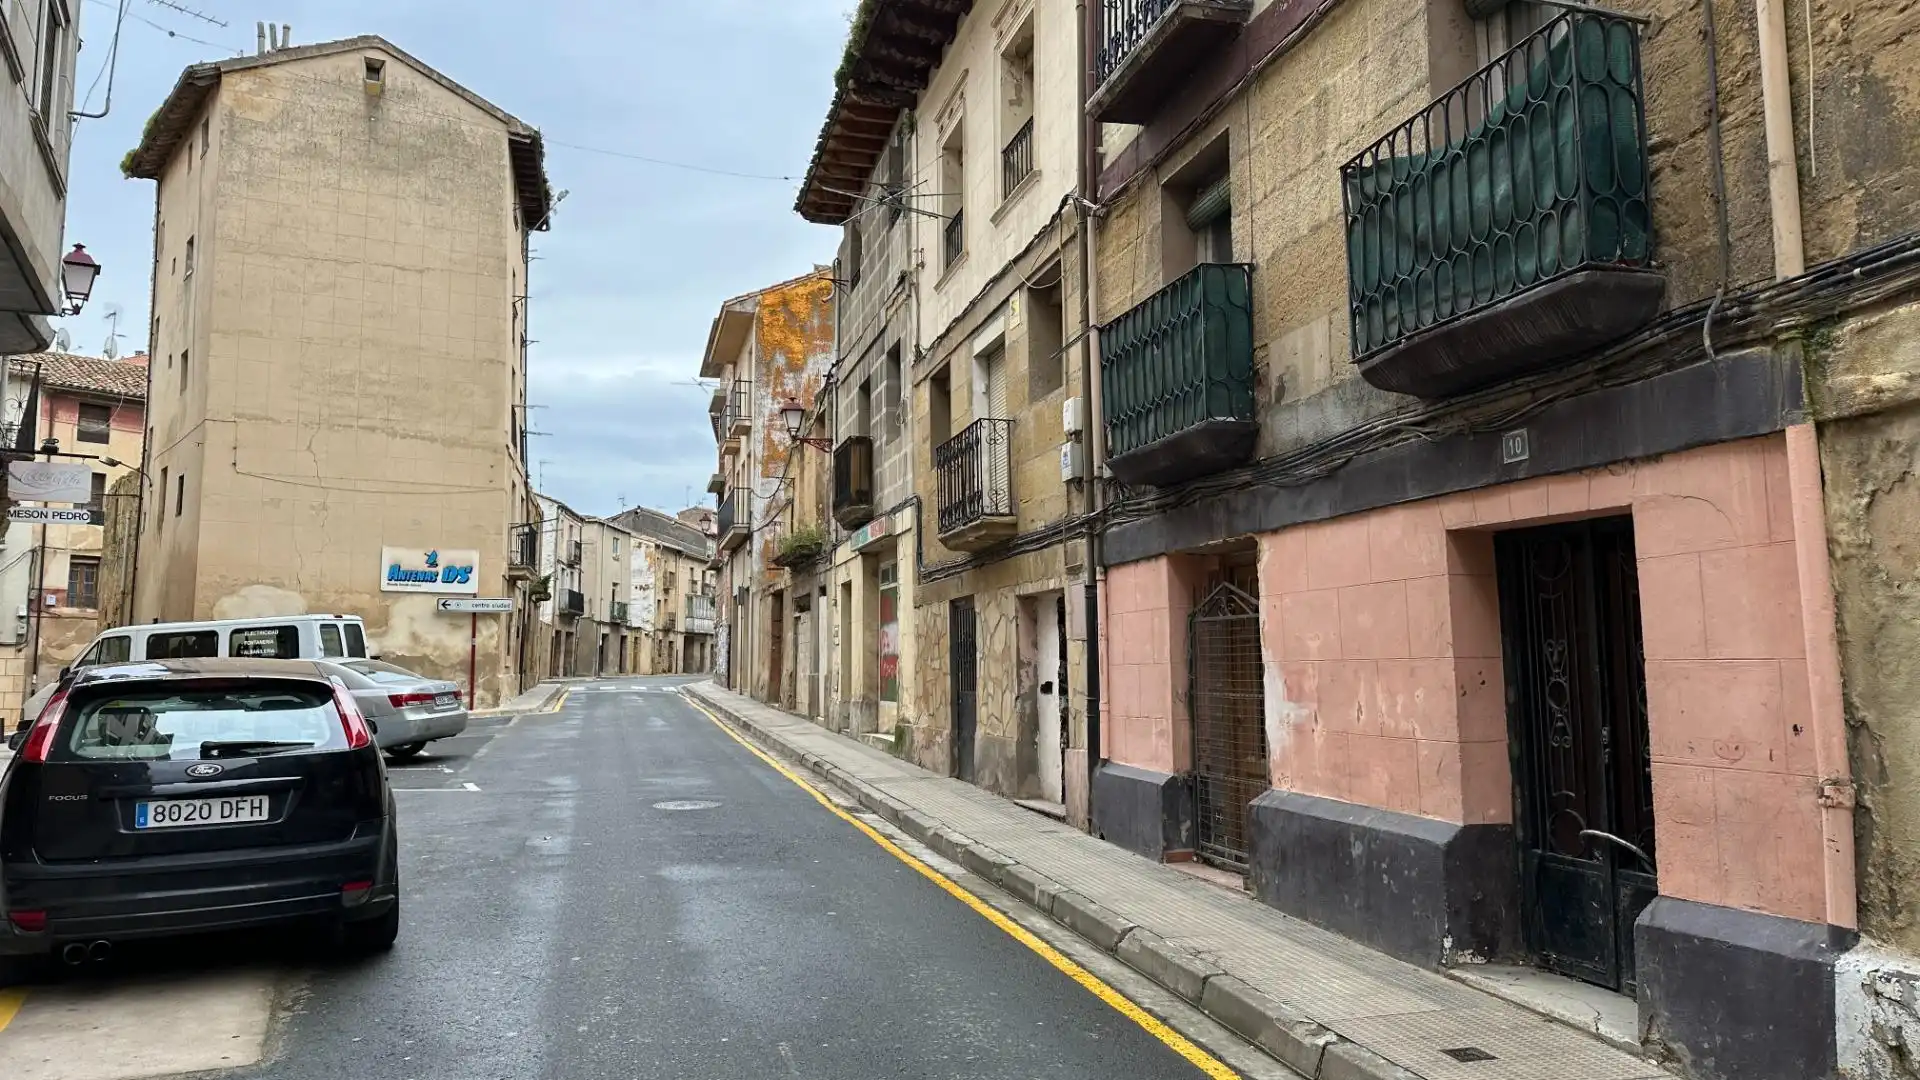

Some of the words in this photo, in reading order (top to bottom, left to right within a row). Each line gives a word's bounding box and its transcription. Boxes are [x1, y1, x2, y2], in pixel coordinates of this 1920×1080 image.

[1509, 437, 1522, 456] 10
[7, 509, 48, 519] MESON
[52, 511, 90, 521] PEDRO
[441, 565, 473, 584] DS
[491, 602, 511, 610] ciudad
[153, 802, 213, 824] 8020
[220, 798, 263, 819] DFH
